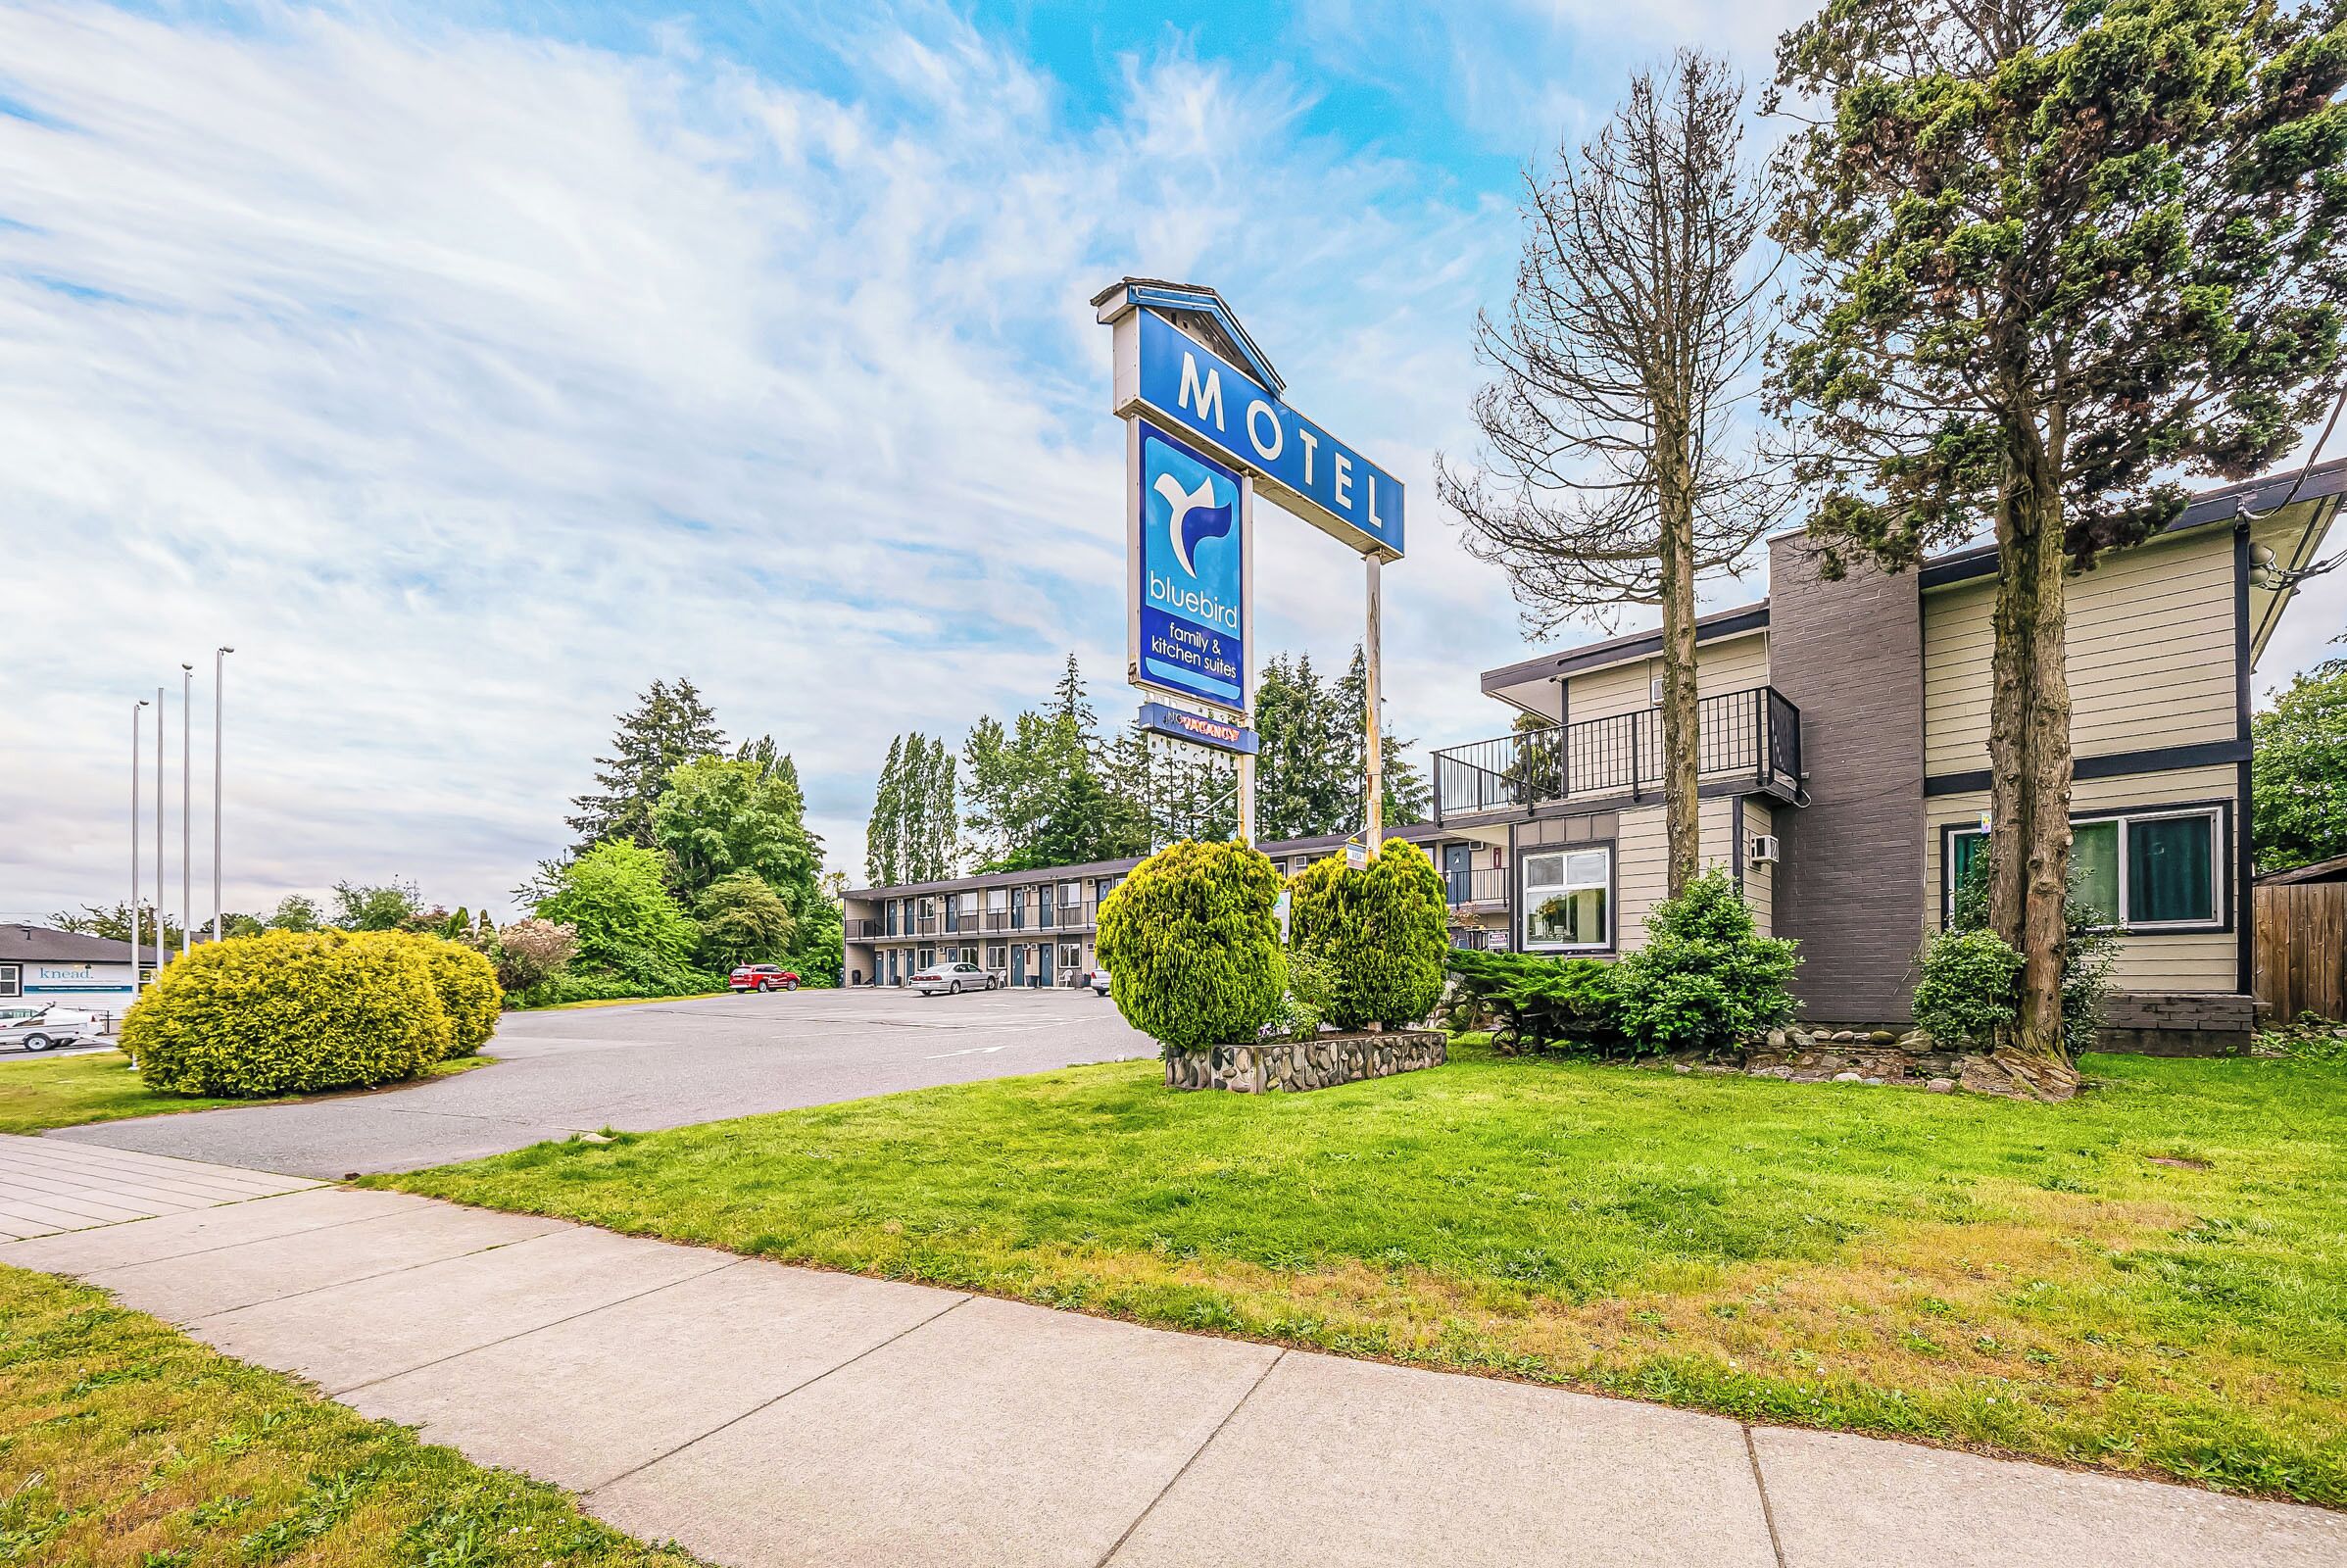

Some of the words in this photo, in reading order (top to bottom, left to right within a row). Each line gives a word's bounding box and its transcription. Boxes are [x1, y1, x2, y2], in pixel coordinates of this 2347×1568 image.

[1178, 351, 1383, 529] MOTEL
[1150, 570, 1237, 629] bluebird
[1151, 635, 1200, 666] kitchen
[1204, 657, 1237, 678] suites
[1169, 622, 1208, 653] family
[1212, 639, 1221, 655] &
[1182, 716, 1240, 742] VACANCY
